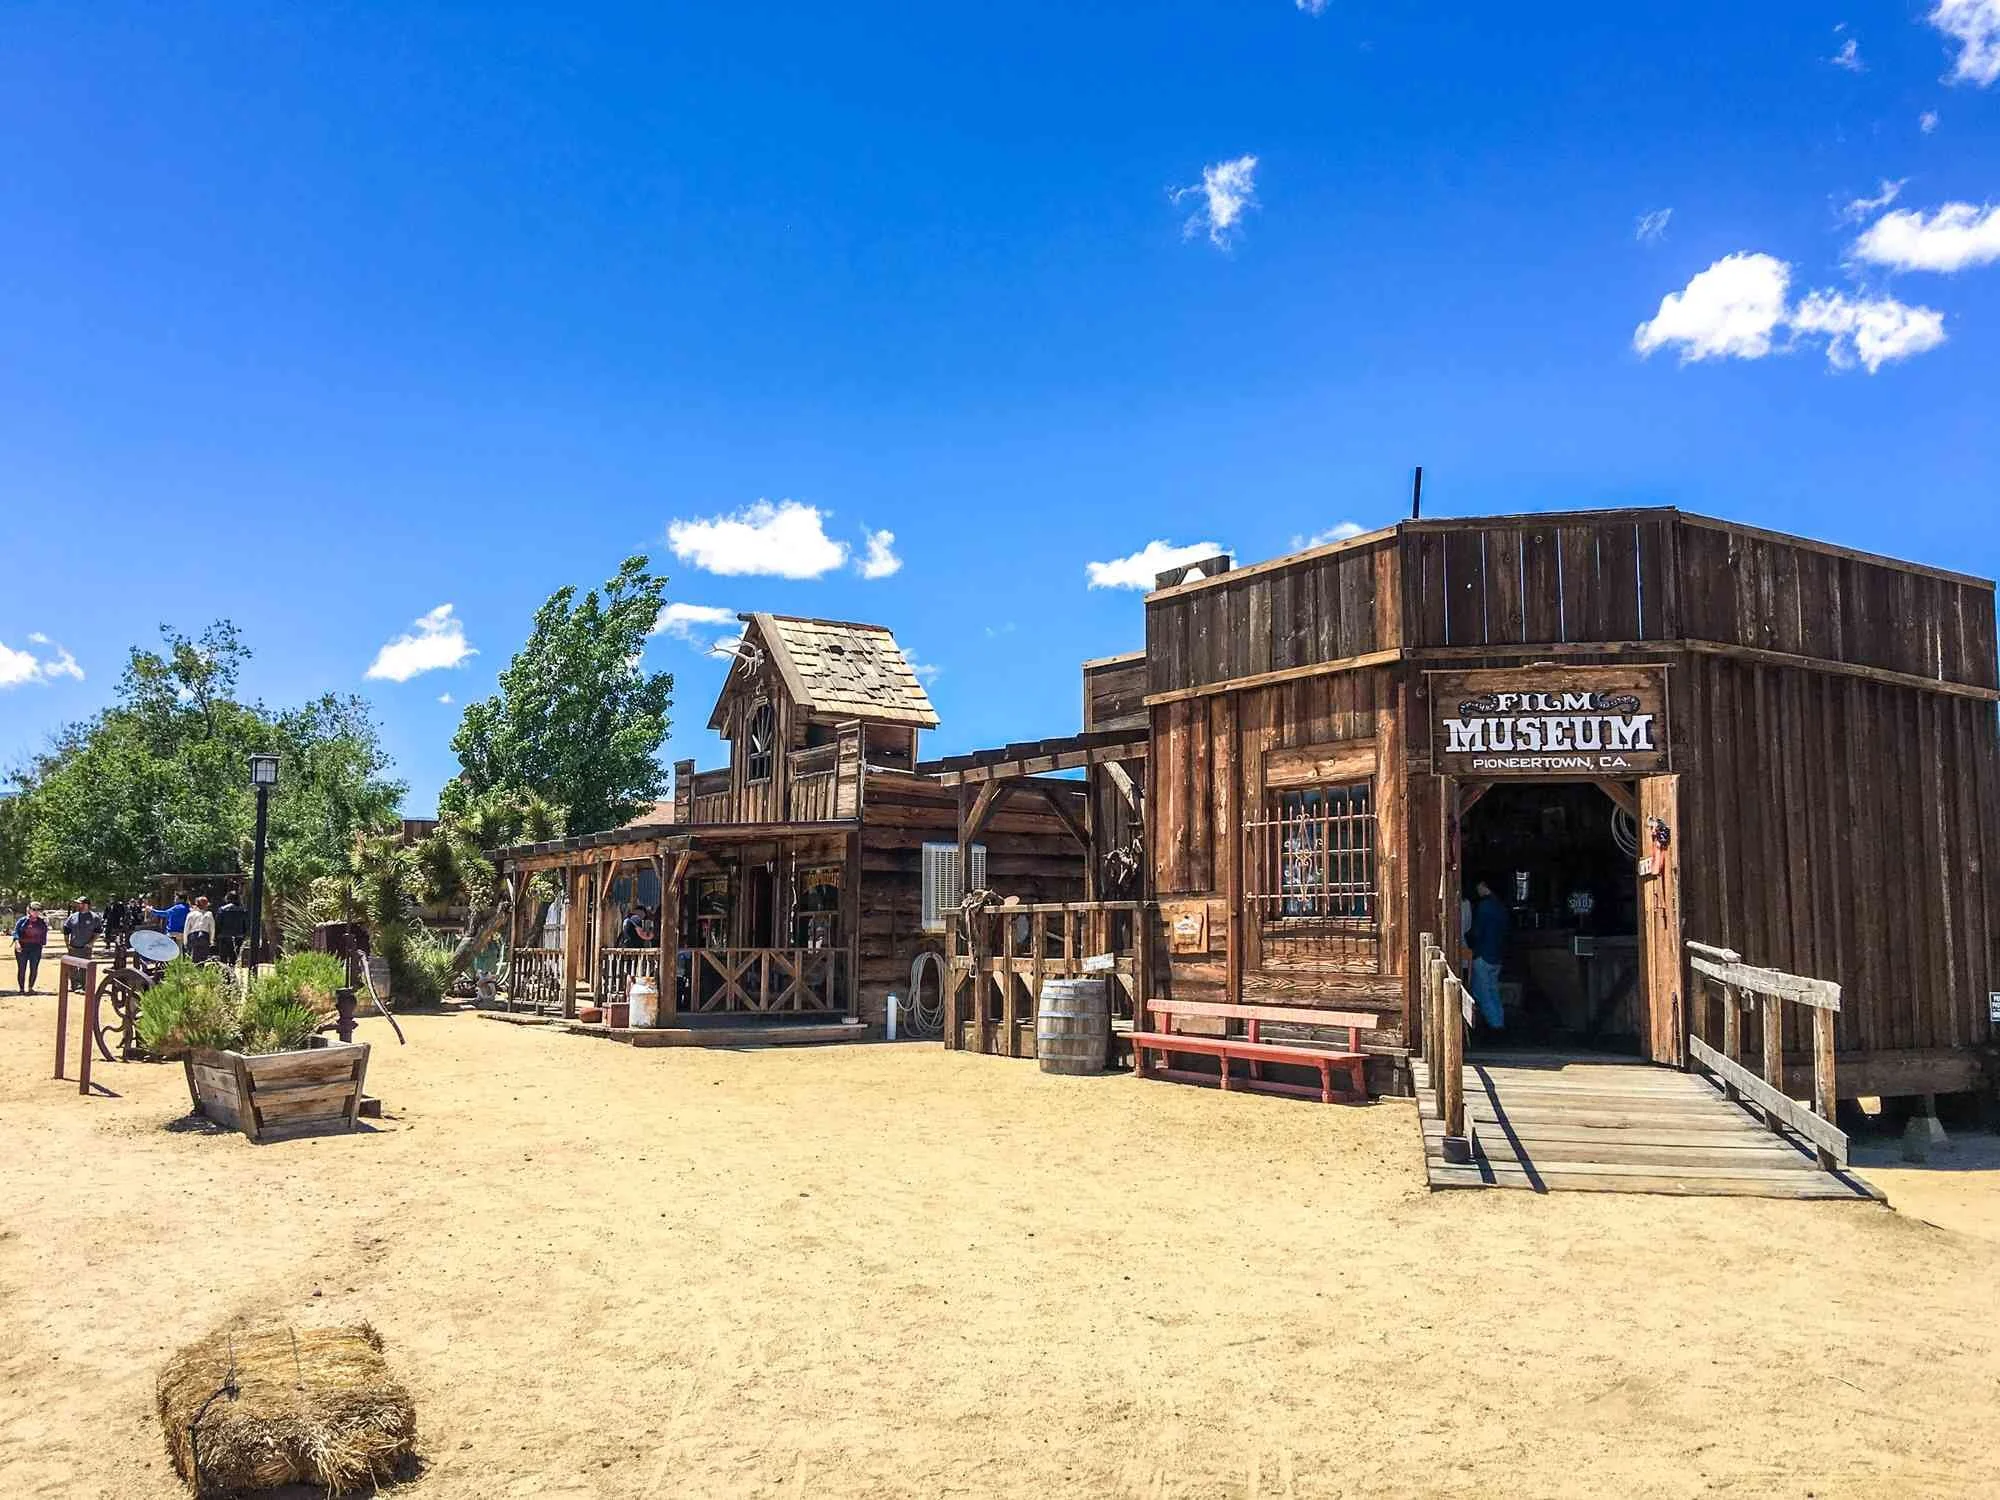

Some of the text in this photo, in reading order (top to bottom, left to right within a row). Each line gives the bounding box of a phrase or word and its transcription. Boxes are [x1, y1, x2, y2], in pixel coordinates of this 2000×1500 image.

[1495, 692, 1594, 712] FILM
[1443, 714, 1654, 752] MUSEUM
[1473, 756, 1631, 770] PIONEERTOWN, CA.
